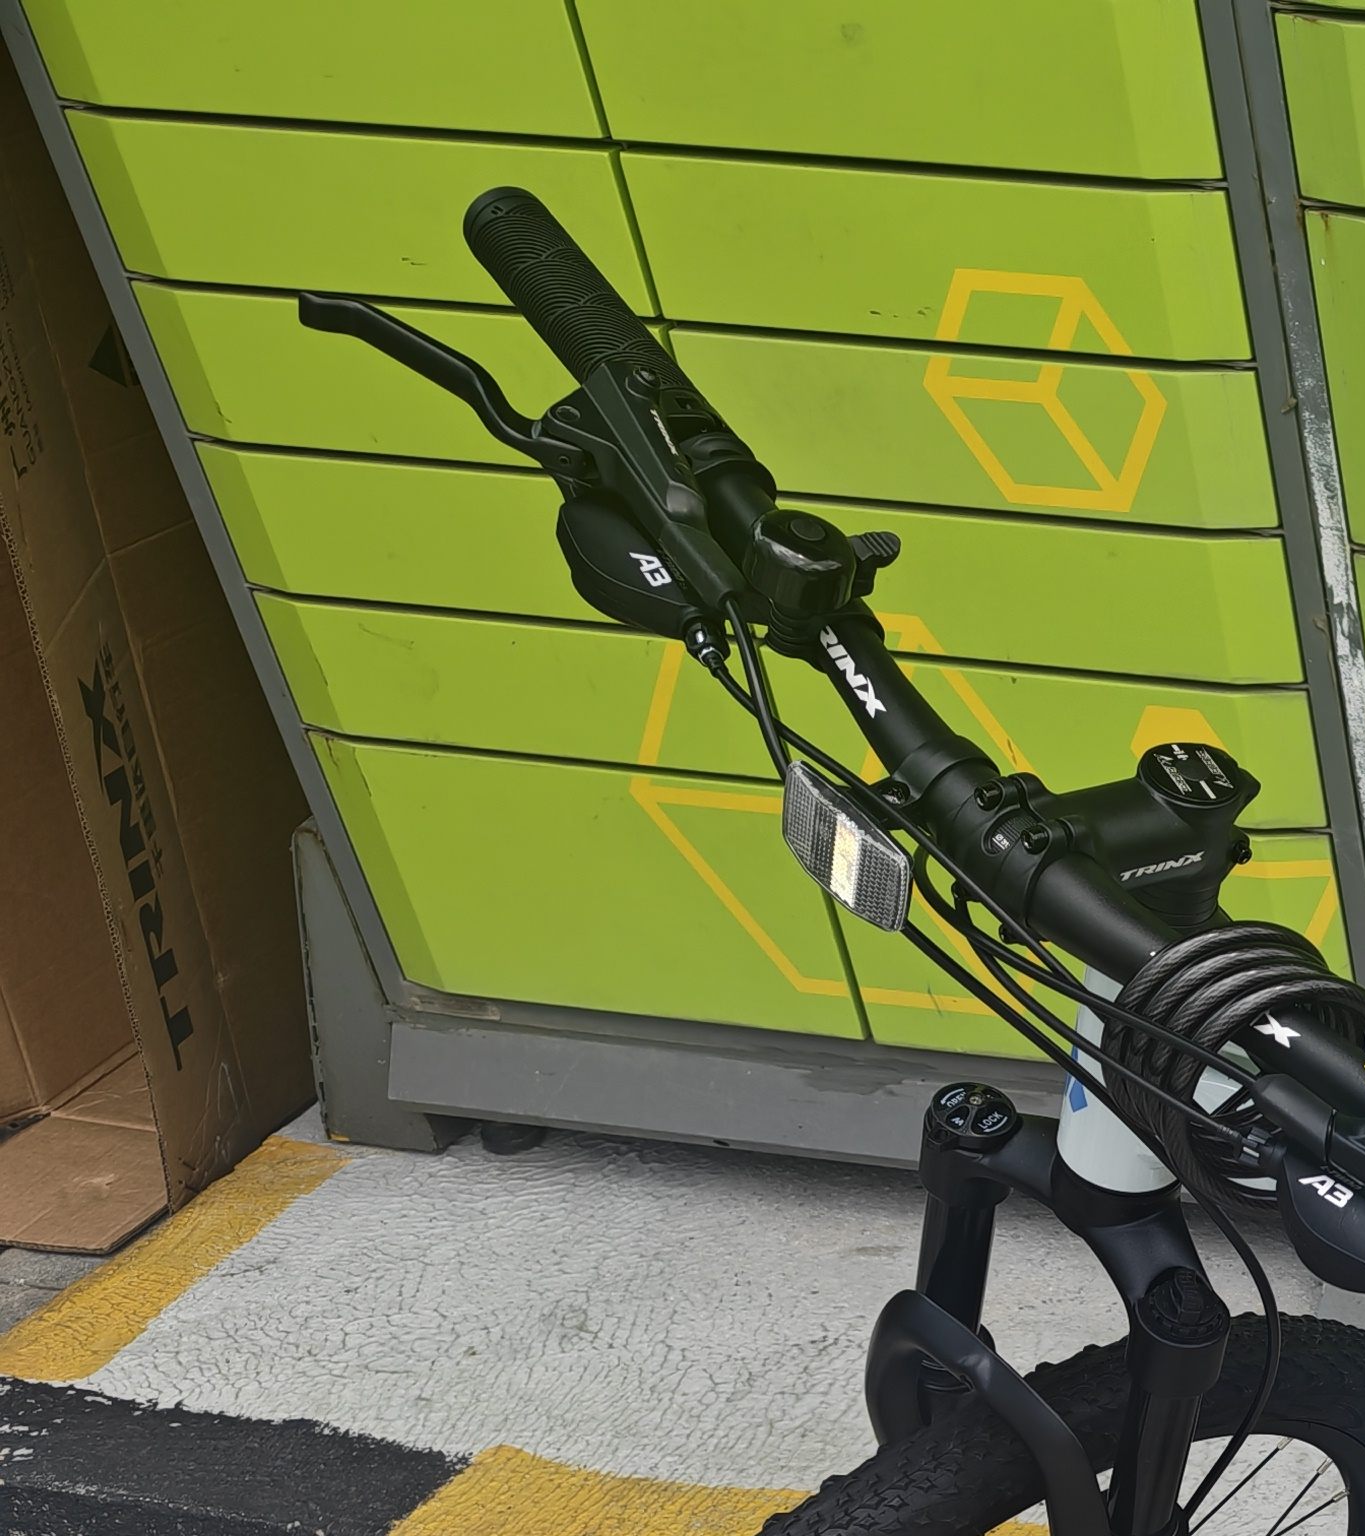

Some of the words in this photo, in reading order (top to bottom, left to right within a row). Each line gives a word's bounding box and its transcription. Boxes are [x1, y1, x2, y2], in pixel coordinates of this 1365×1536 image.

[629, 551, 673, 588] A3
[820, 624, 888, 719] RINX
[78, 657, 194, 1071] TRINX
[1119, 850, 1206, 882] TRINX
[977, 1111, 1004, 1129] LOCK
[1298, 1174, 1354, 1209] A3
